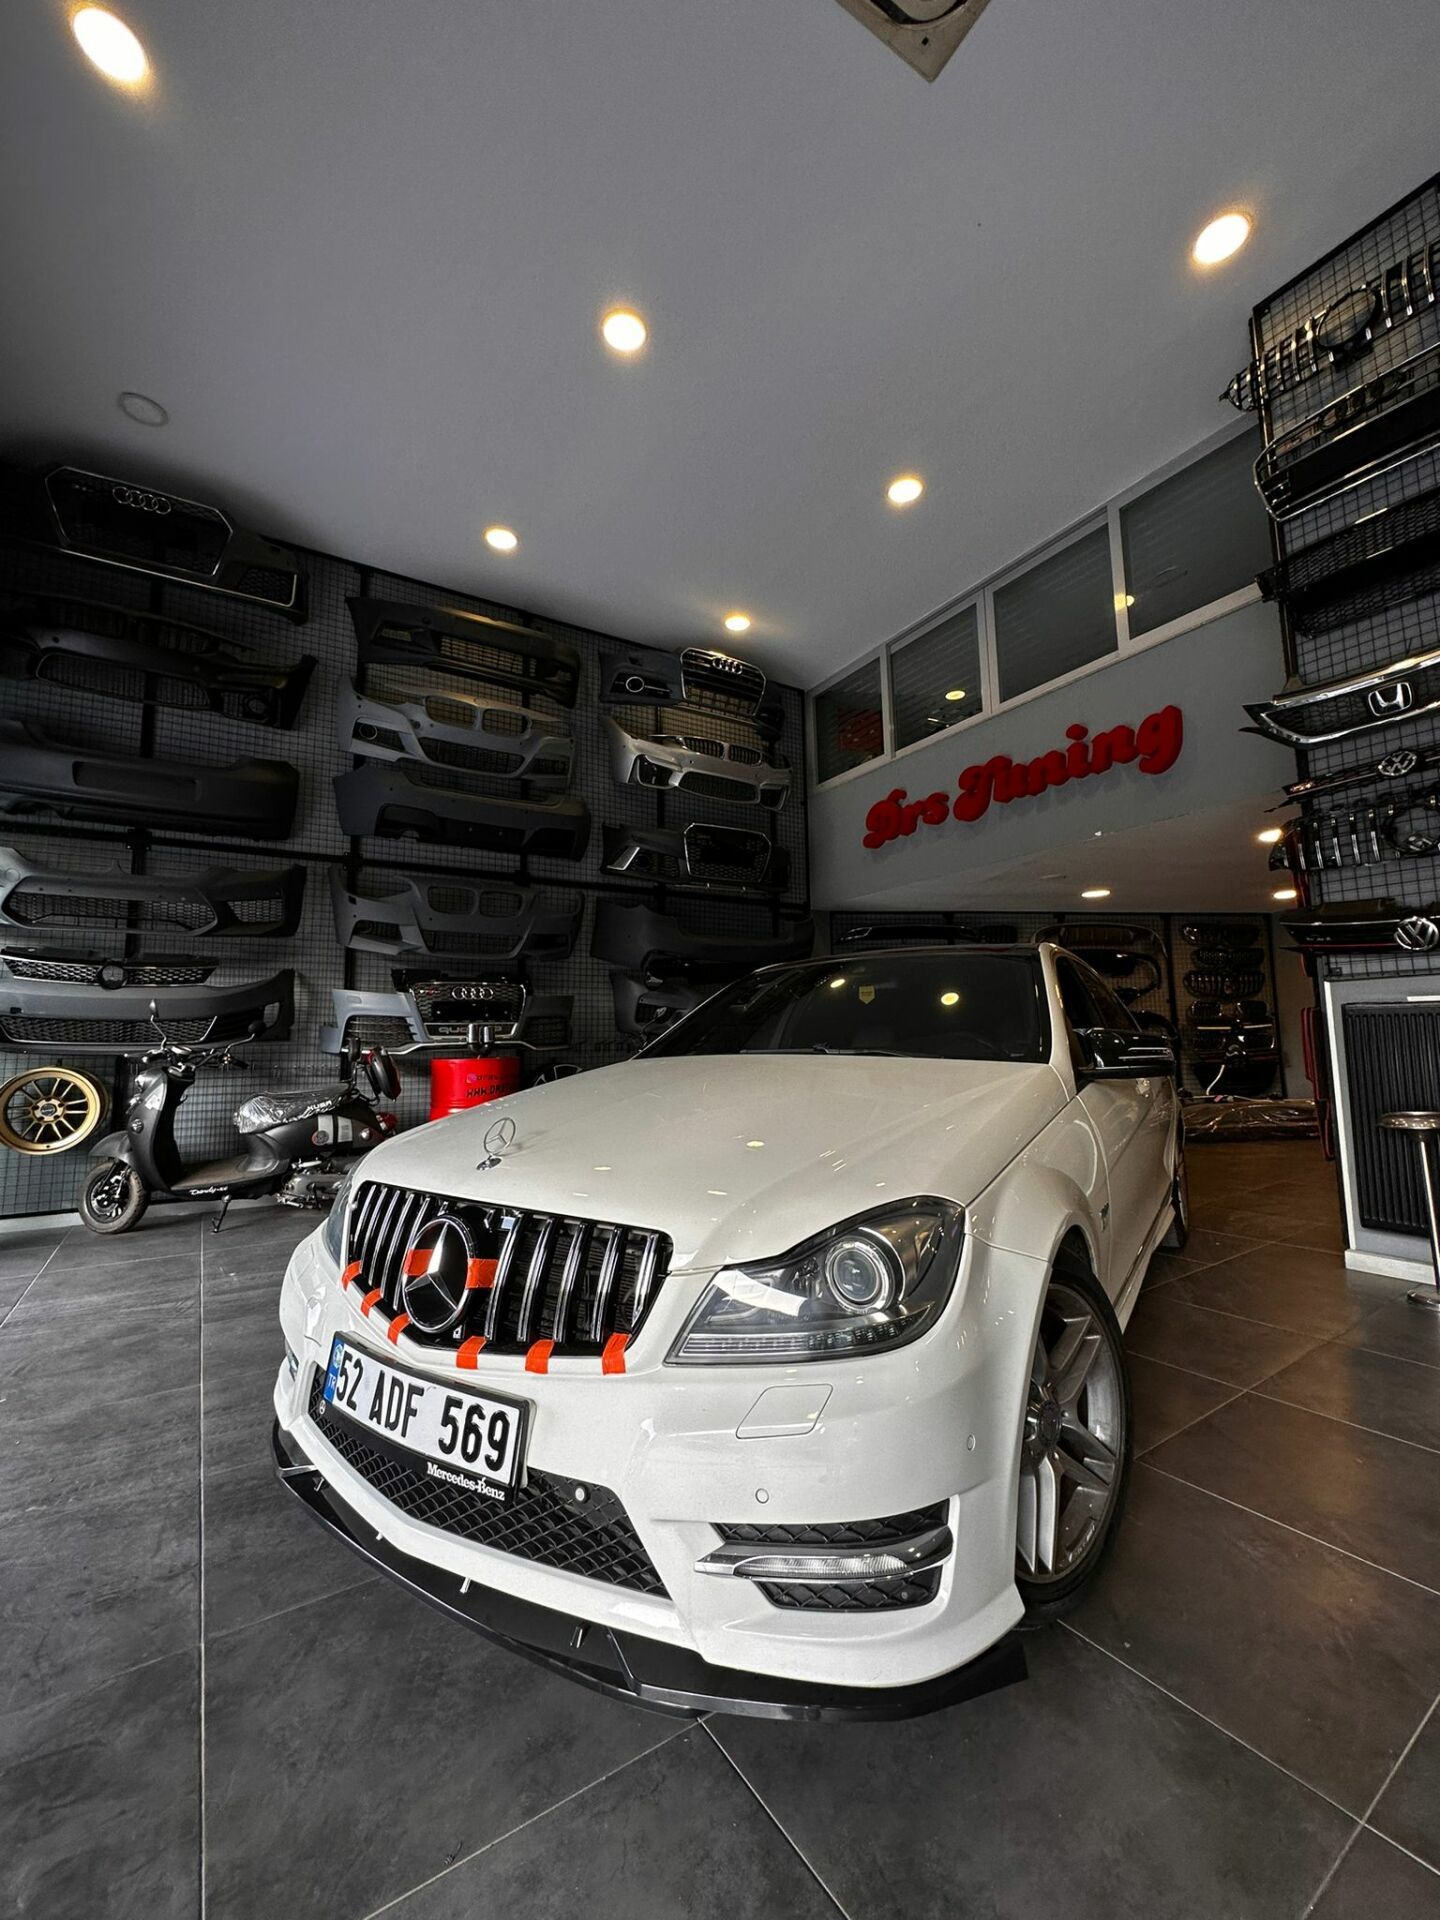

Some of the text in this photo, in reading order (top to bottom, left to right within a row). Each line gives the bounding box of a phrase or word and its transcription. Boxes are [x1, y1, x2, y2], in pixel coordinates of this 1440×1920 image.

[953, 705, 1184, 822] Tuning
[327, 1372, 337, 1389] TR
[336, 1351, 511, 1472] 52 ADF 569
[426, 1462, 506, 1501] Mercedes-Benz
